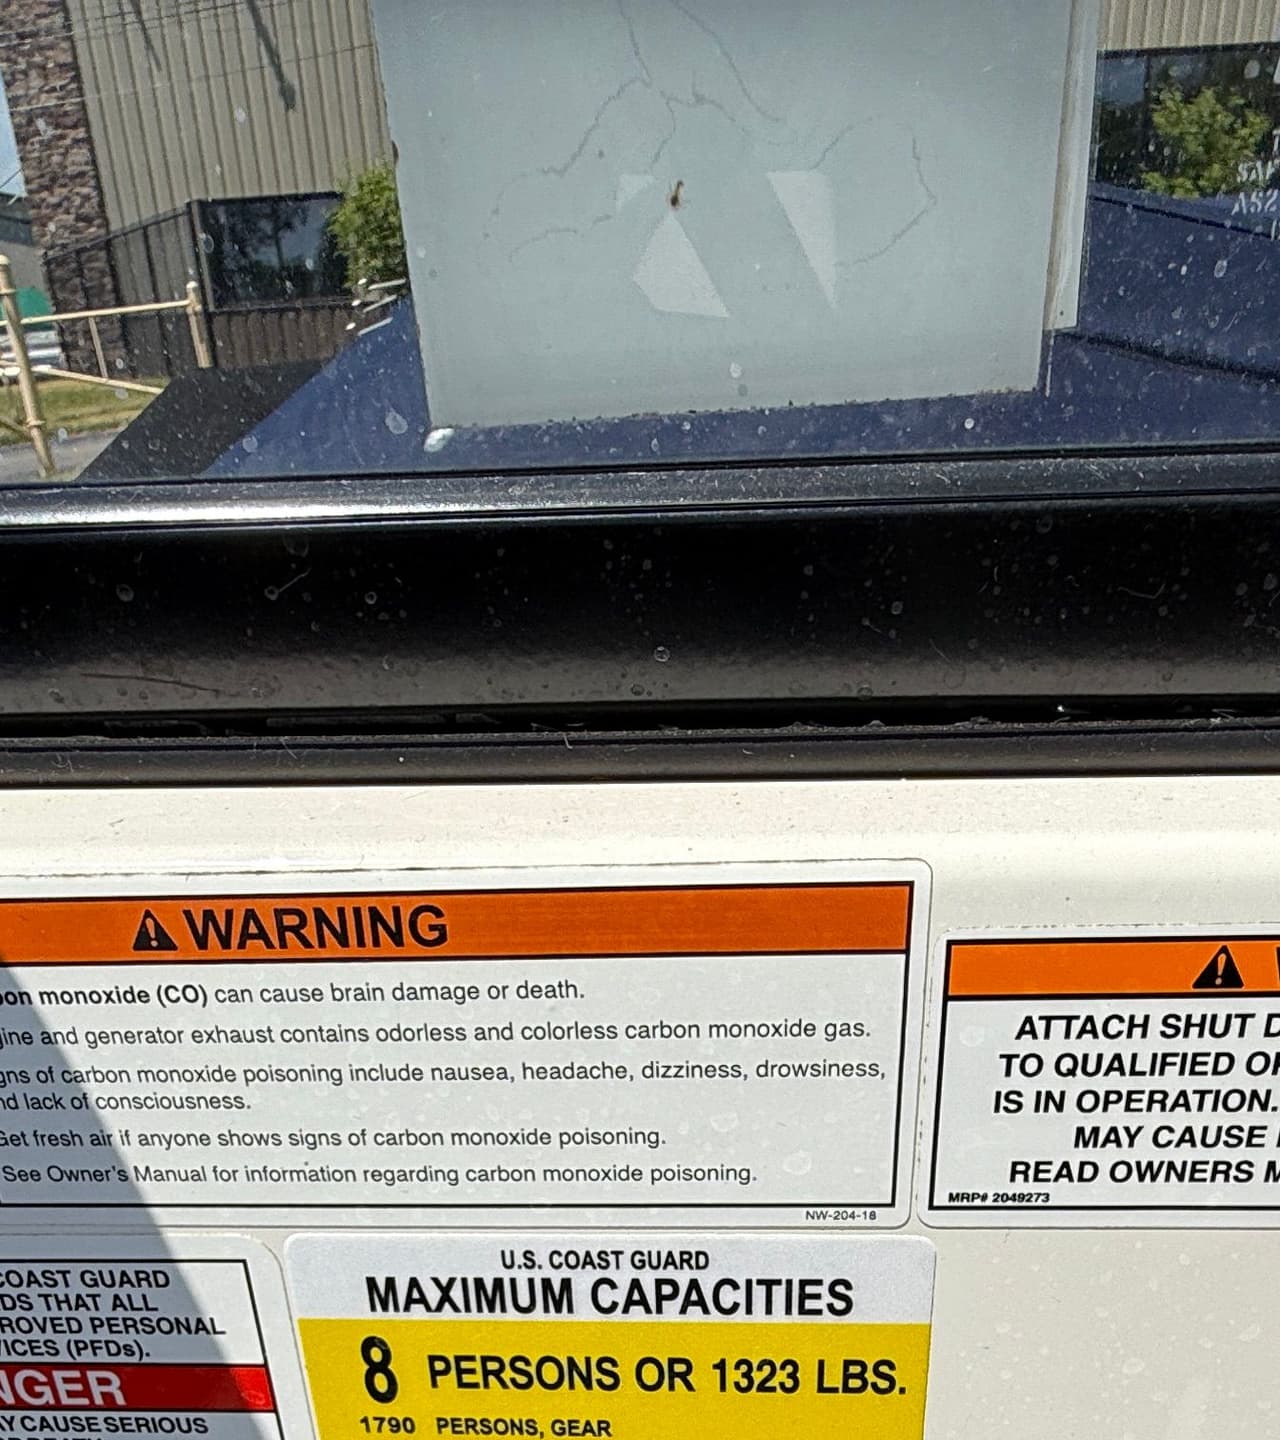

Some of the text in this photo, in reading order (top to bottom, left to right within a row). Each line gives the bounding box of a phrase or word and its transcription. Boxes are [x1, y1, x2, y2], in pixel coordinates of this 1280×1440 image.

[182, 905, 448, 950] WARNING
[39, 986, 150, 1005] monoxide
[157, 984, 208, 1008] (CO)
[214, 988, 253, 1003] can
[260, 988, 324, 1003] cause
[330, 982, 385, 1002] brain
[392, 982, 479, 1005] damage
[487, 985, 509, 1000] or
[516, 979, 584, 999] death.
[40, 1026, 79, 1045] and
[85, 1027, 184, 1049] generator
[191, 1025, 275, 1044] exhaust
[280, 1024, 369, 1043] contains
[376, 1023, 467, 1042] odorless
[474, 1022, 513, 1041] and
[521, 1021, 618, 1040] colorless
[625, 1020, 700, 1039] carbon
[709, 1018, 816, 1038] monoxide
[824, 1022, 870, 1042] gas.
[1015, 1014, 1150, 1040] ATTACH
[1160, 1013, 1256, 1039] SHUT
[999, 1053, 1044, 1078] TO
[1054, 1052, 1235, 1077] QUALIFIED
[994, 1090, 1023, 1114] IS
[1034, 1090, 1066, 1113] IN
[1076, 1089, 1278, 1113] OPERATION.
[33, 1130, 84, 1147] fresh
[89, 1129, 113, 1147] air
[119, 1129, 131, 1146] if
[138, 1133, 211, 1151] anyone
[217, 1129, 282, 1146] shows
[288, 1129, 342, 1150] signs
[348, 1128, 367, 1146] of
[374, 1129, 444, 1146] carbon
[451, 1128, 551, 1146] monoxide
[559, 1127, 666, 1149] poisoning.
[1074, 1126, 1144, 1148] MAY
[1152, 1125, 1268, 1148] CAUSE
[1010, 1161, 1099, 1183] READ
[1109, 1160, 1254, 1183] OWNERS
[501, 1250, 709, 1270] U.S. COAST GUARD
[80, 1269, 170, 1288] GUARD
[37, 1293, 101, 1311] THAT
[112, 1293, 159, 1311] ALL
[366, 1276, 853, 1317] MAXIMUM CAPACITIES
[361, 1336, 906, 1403] 8 PERSONS OR 1323 LBS.
[360, 1416, 612, 1439] 1790 PERSONS, GEAR
